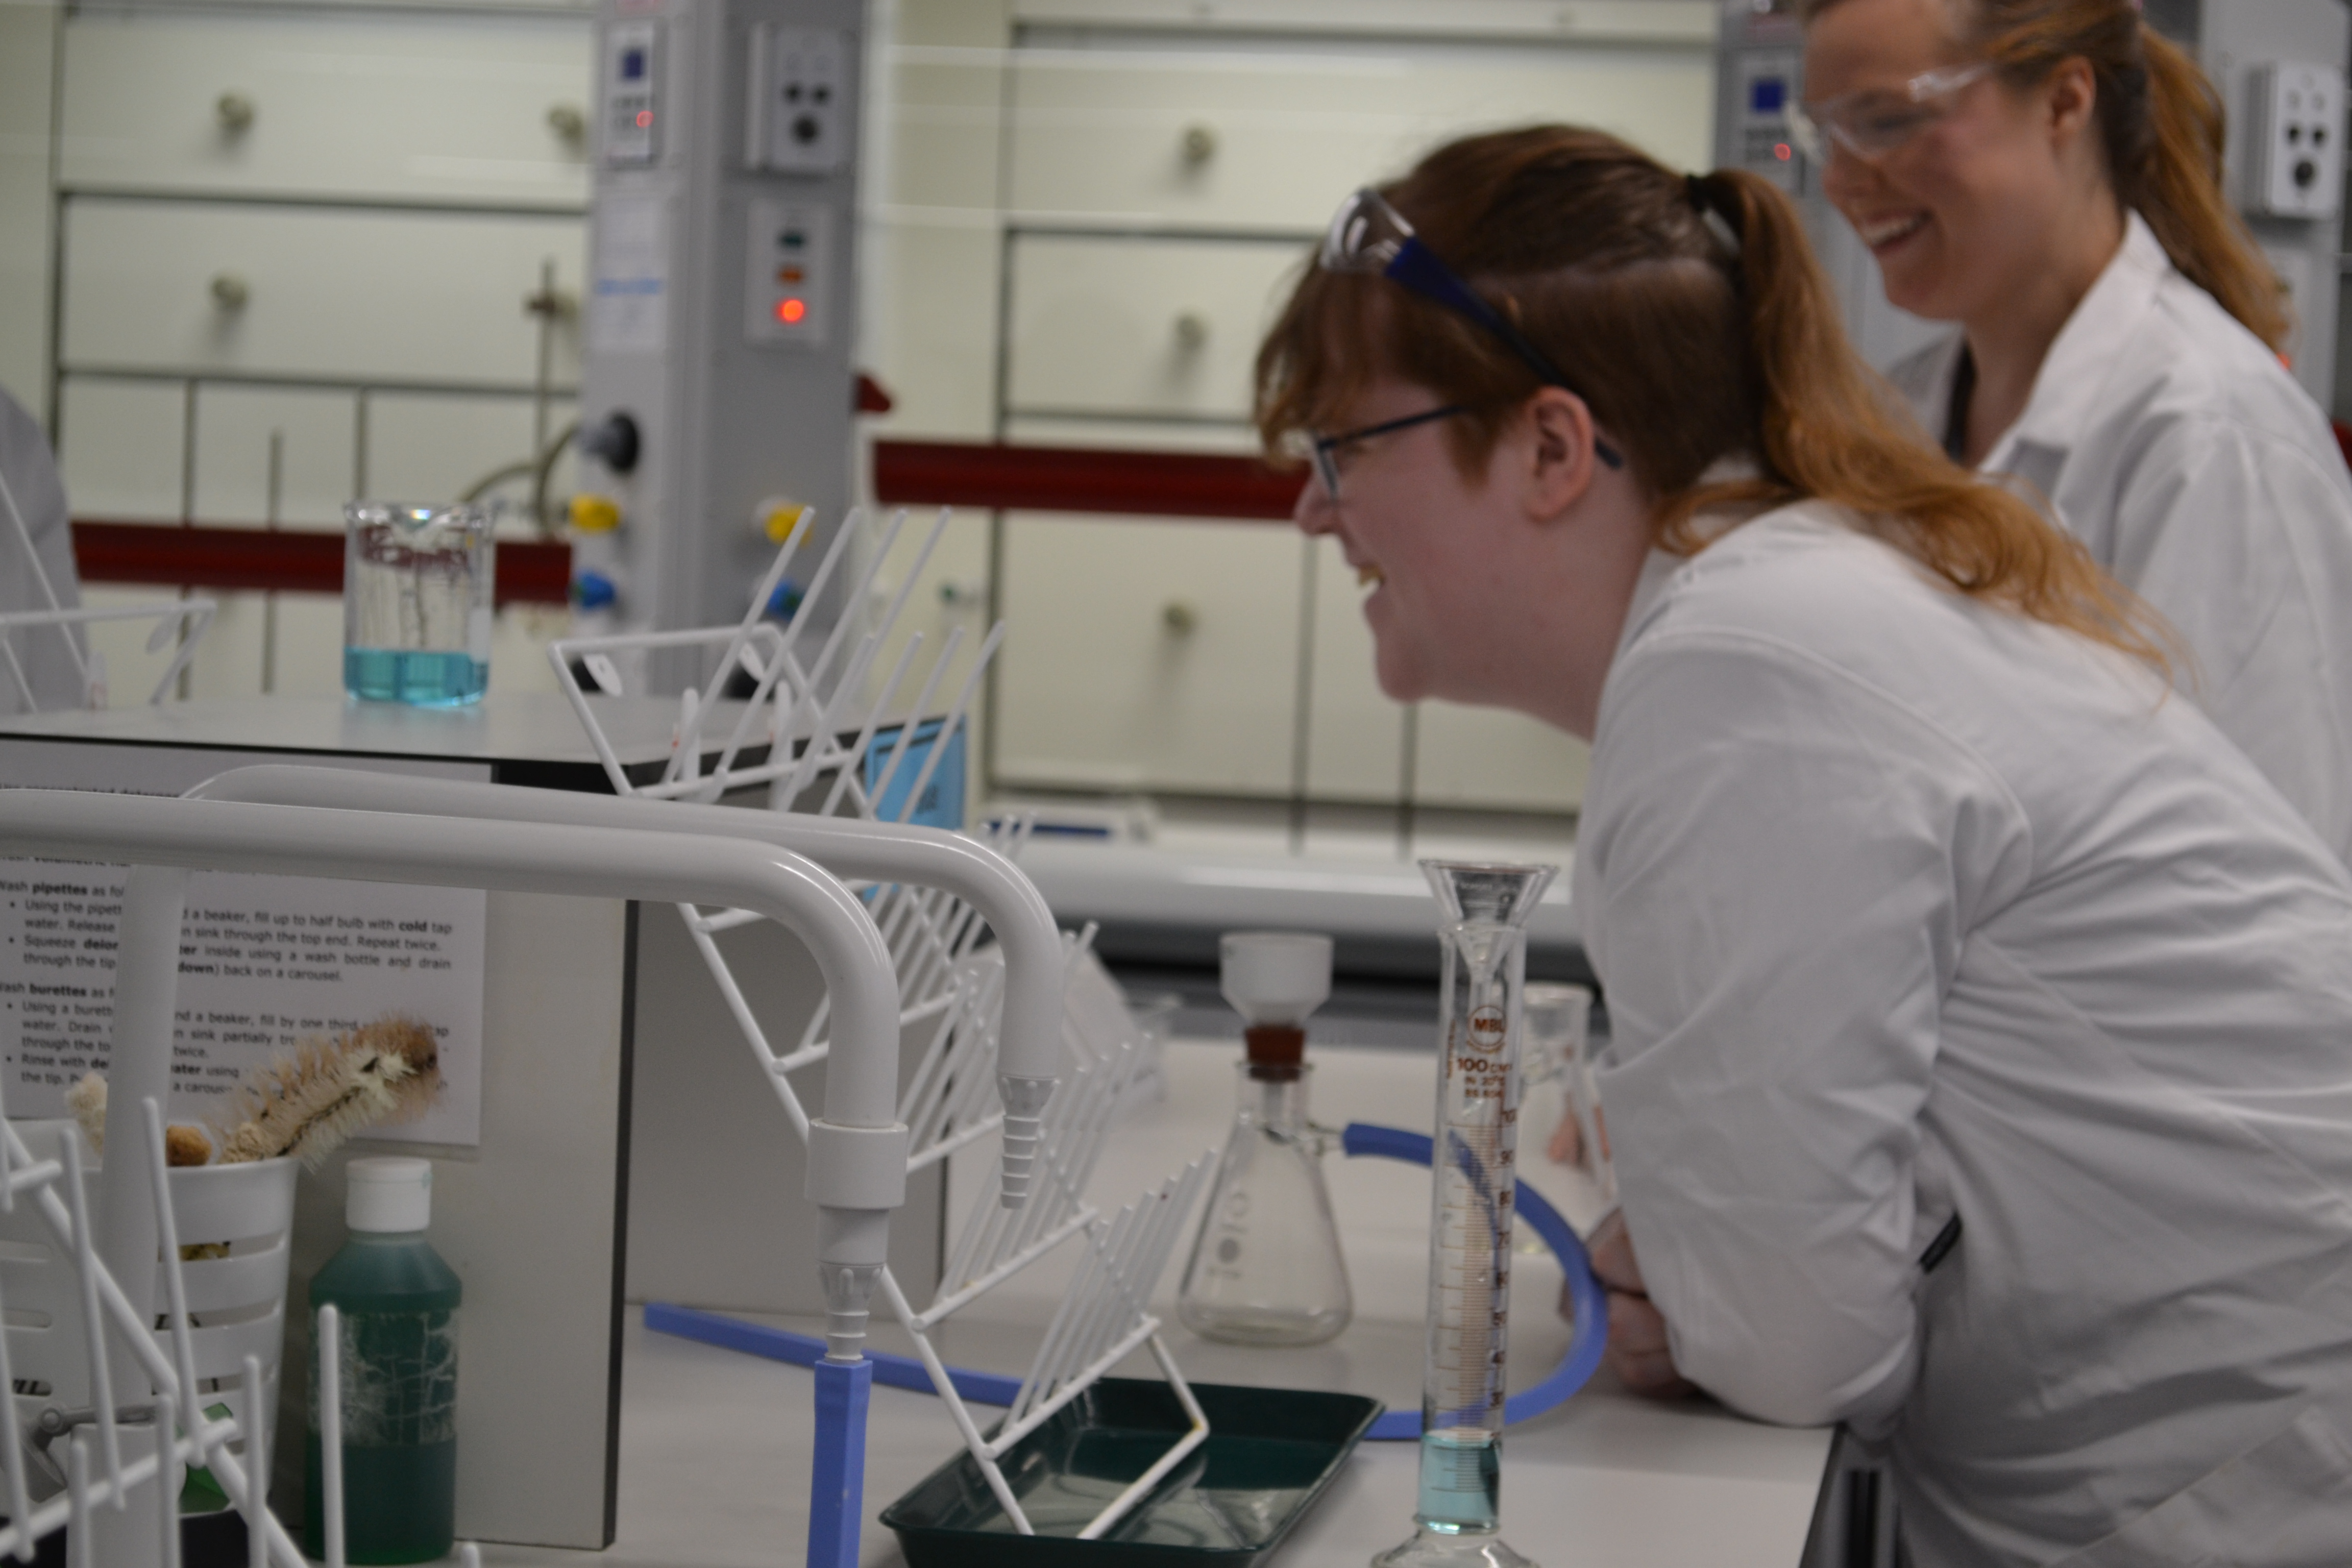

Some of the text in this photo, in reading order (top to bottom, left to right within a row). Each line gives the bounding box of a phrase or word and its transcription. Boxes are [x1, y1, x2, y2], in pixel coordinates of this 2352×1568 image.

[32, 882, 87, 896] pipettes
[92, 887, 105, 896] as
[26, 900, 122, 916] Using the pipett
[26, 919, 115, 933] water. Release
[205, 908, 250, 924] beaker,
[309, 915, 333, 927] half
[368, 920, 394, 930] with
[399, 920, 427, 933] cold
[432, 923, 452, 935] tap
[195, 926, 219, 939] sink
[224, 927, 273, 943] through
[276, 930, 297, 943] the
[325, 935, 350, 946] end.
[357, 936, 400, 949] Repeat
[404, 939, 440, 951] twice.
[23, 952, 71, 968] through
[76, 955, 96, 967] the
[248, 948, 281, 963] using
[305, 953, 337, 964] wash
[419, 957, 451, 969] drain
[224, 964, 252, 976] back
[287, 968, 342, 982] carousel.
[29, 983, 87, 996] burettes
[91, 988, 105, 998] as
[22, 1001, 57, 1016] Using
[74, 1004, 113, 1016] burett
[22, 1020, 61, 1032] water.
[208, 1011, 255, 1027] beaker,
[21, 1036, 71, 1052] through
[74, 1039, 94, 1051] the
[190, 1028, 215, 1041] sink
[222, 1031, 273, 1046] partially
[21, 1053, 55, 1066] Rinse
[60, 1056, 86, 1067] with
[1458, 1058, 1488, 1072] 100
[21, 1071, 41, 1083] the
[206, 1067, 239, 1080] using
